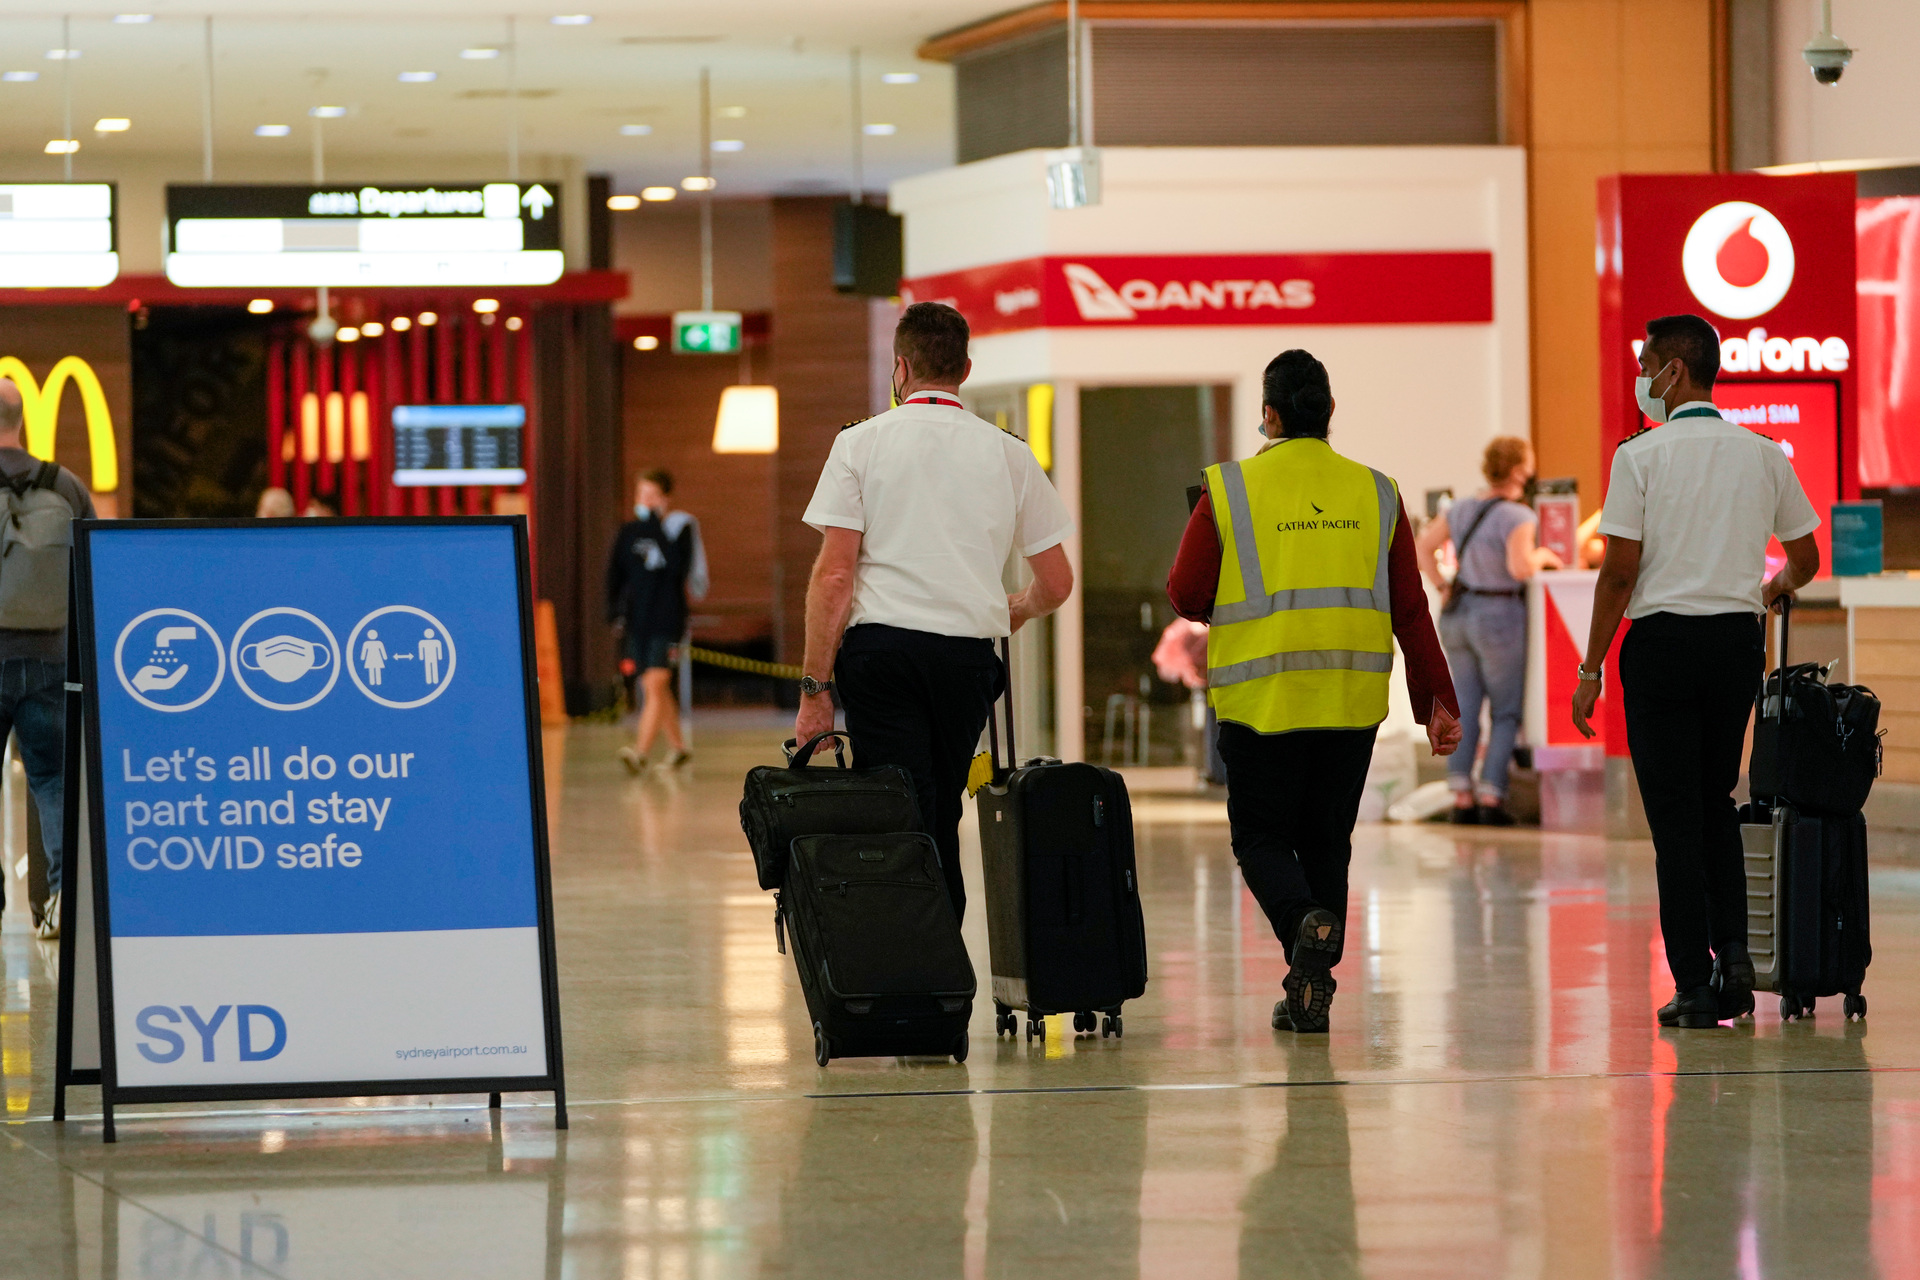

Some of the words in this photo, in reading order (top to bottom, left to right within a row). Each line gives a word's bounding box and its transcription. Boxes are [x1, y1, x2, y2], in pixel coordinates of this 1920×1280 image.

[359, 187, 483, 218] Departures
[1119, 279, 1316, 310] QANTAS
[1277, 520, 1319, 532] CATHAY
[1322, 519, 1360, 530] PACIFIC
[122, 747, 217, 782] Let’s
[228, 746, 271, 781] all
[283, 746, 337, 780] do
[348, 752, 415, 779] our
[126, 793, 209, 834] part
[219, 790, 296, 826] and
[307, 791, 392, 831] stay
[127, 835, 265, 871] COVID
[276, 833, 363, 869] safe
[135, 1004, 288, 1064] SYD
[395, 1045, 528, 1061] sydneyairport.com.au
